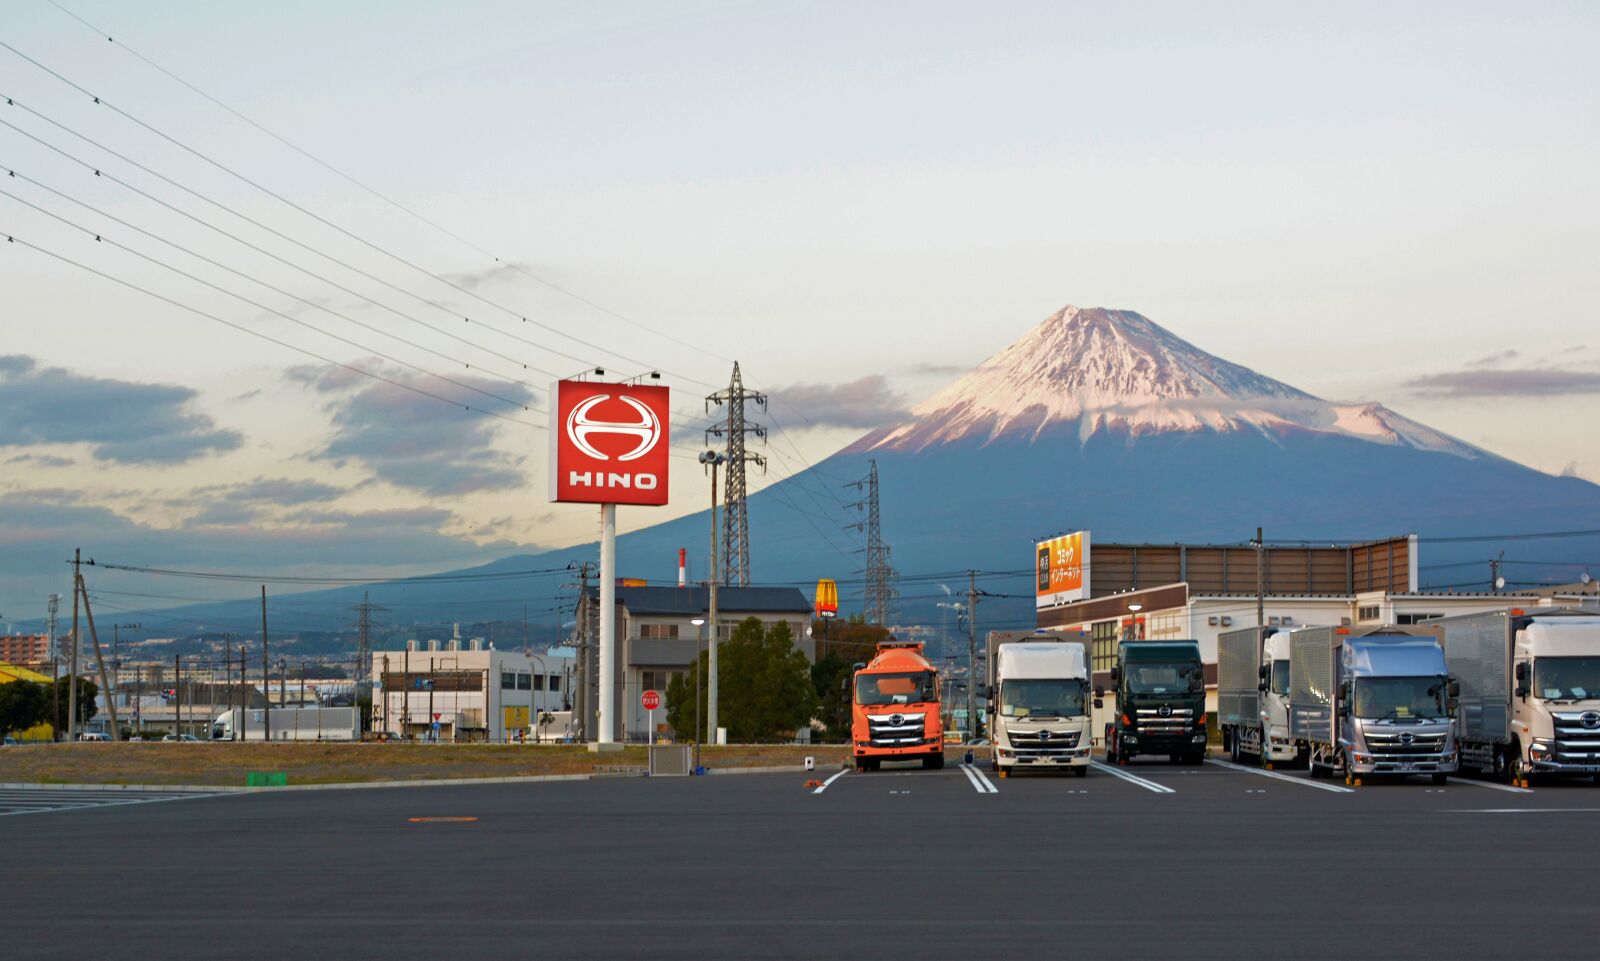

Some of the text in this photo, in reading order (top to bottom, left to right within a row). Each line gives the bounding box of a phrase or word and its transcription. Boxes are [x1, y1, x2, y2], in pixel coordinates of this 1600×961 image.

[569, 471, 658, 490] HINO
[1057, 546, 1074, 564] コミック
[1051, 563, 1081, 584] インターネット
